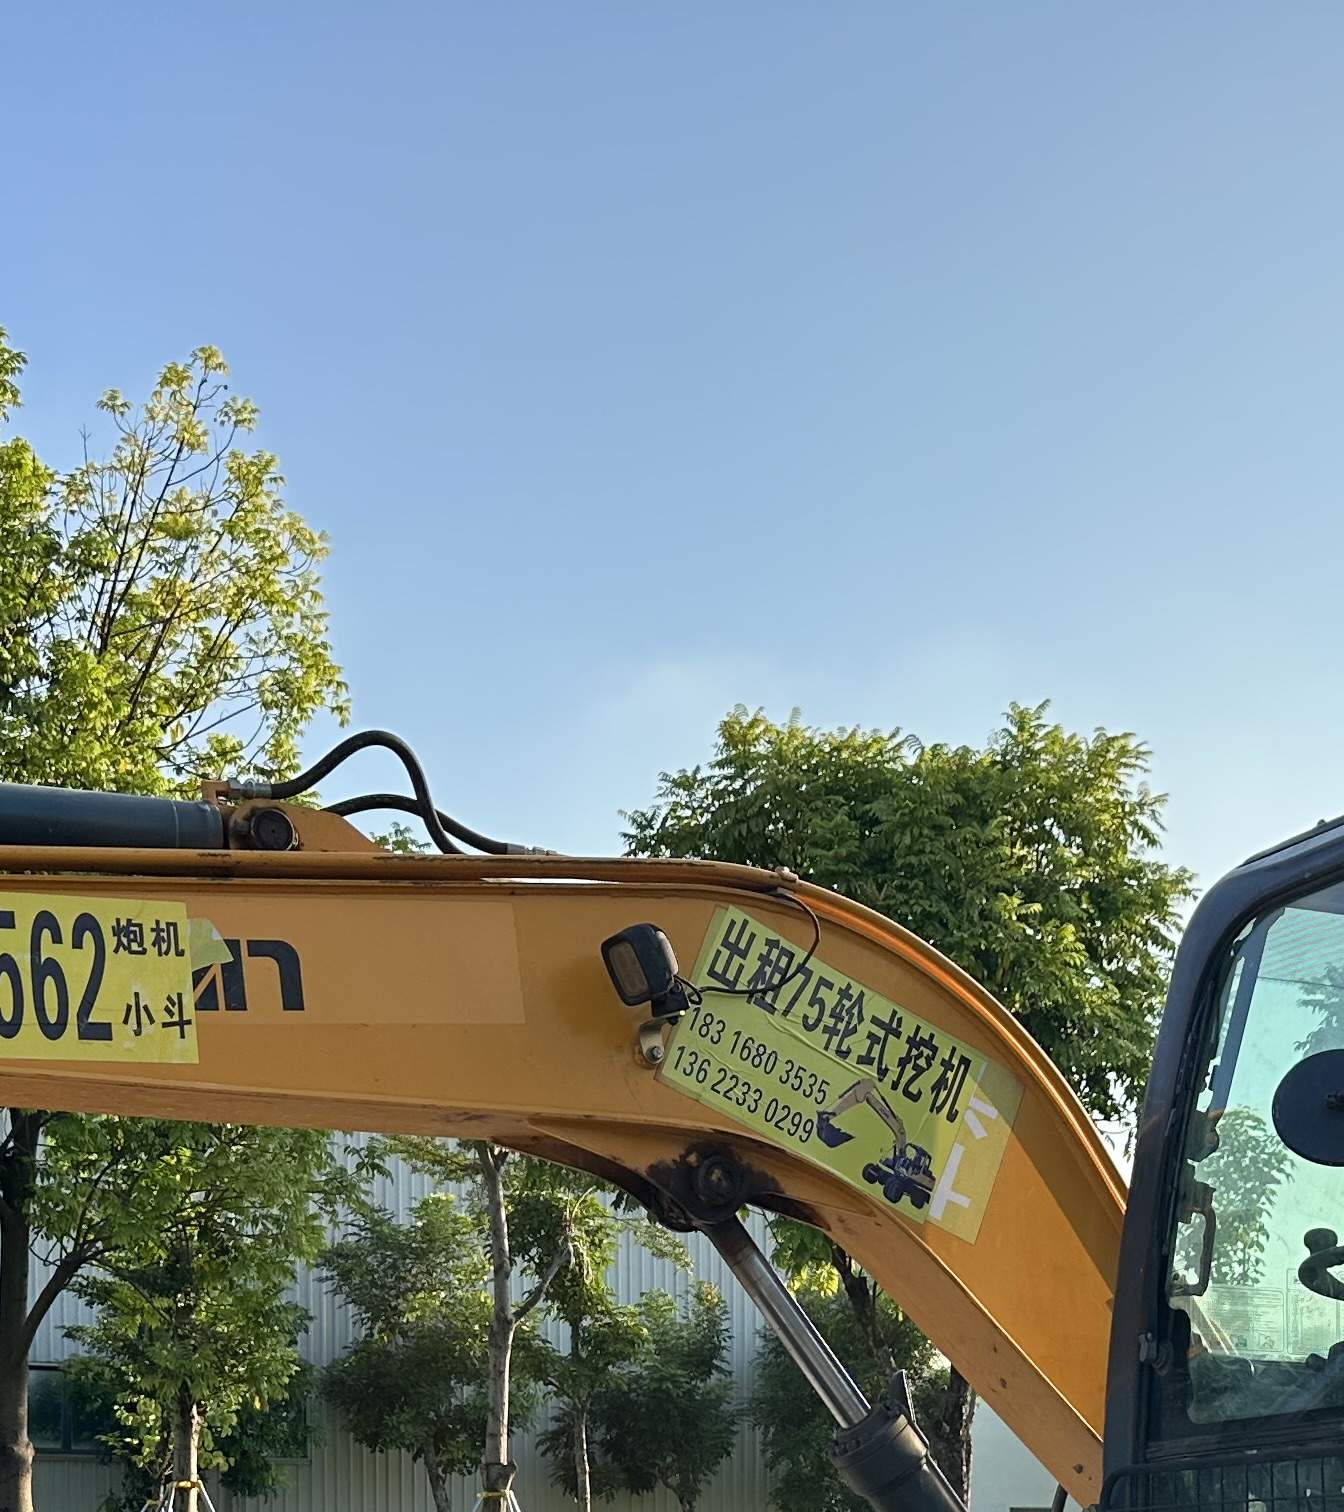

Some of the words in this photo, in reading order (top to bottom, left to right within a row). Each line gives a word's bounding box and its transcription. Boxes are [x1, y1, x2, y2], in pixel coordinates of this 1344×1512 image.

[111, 917, 186, 957] 炮机
[121, 992, 193, 1040] 小斗
[689, 1006, 726, 1045] 183
[730, 1030, 778, 1075] 1680
[779, 1059, 830, 1105] 3535
[707, 918, 972, 1123] 出租75轮式挖机
[674, 1045, 711, 1084] 136
[710, 1067, 763, 1114] 2233
[764, 1098, 815, 1144] 0299
